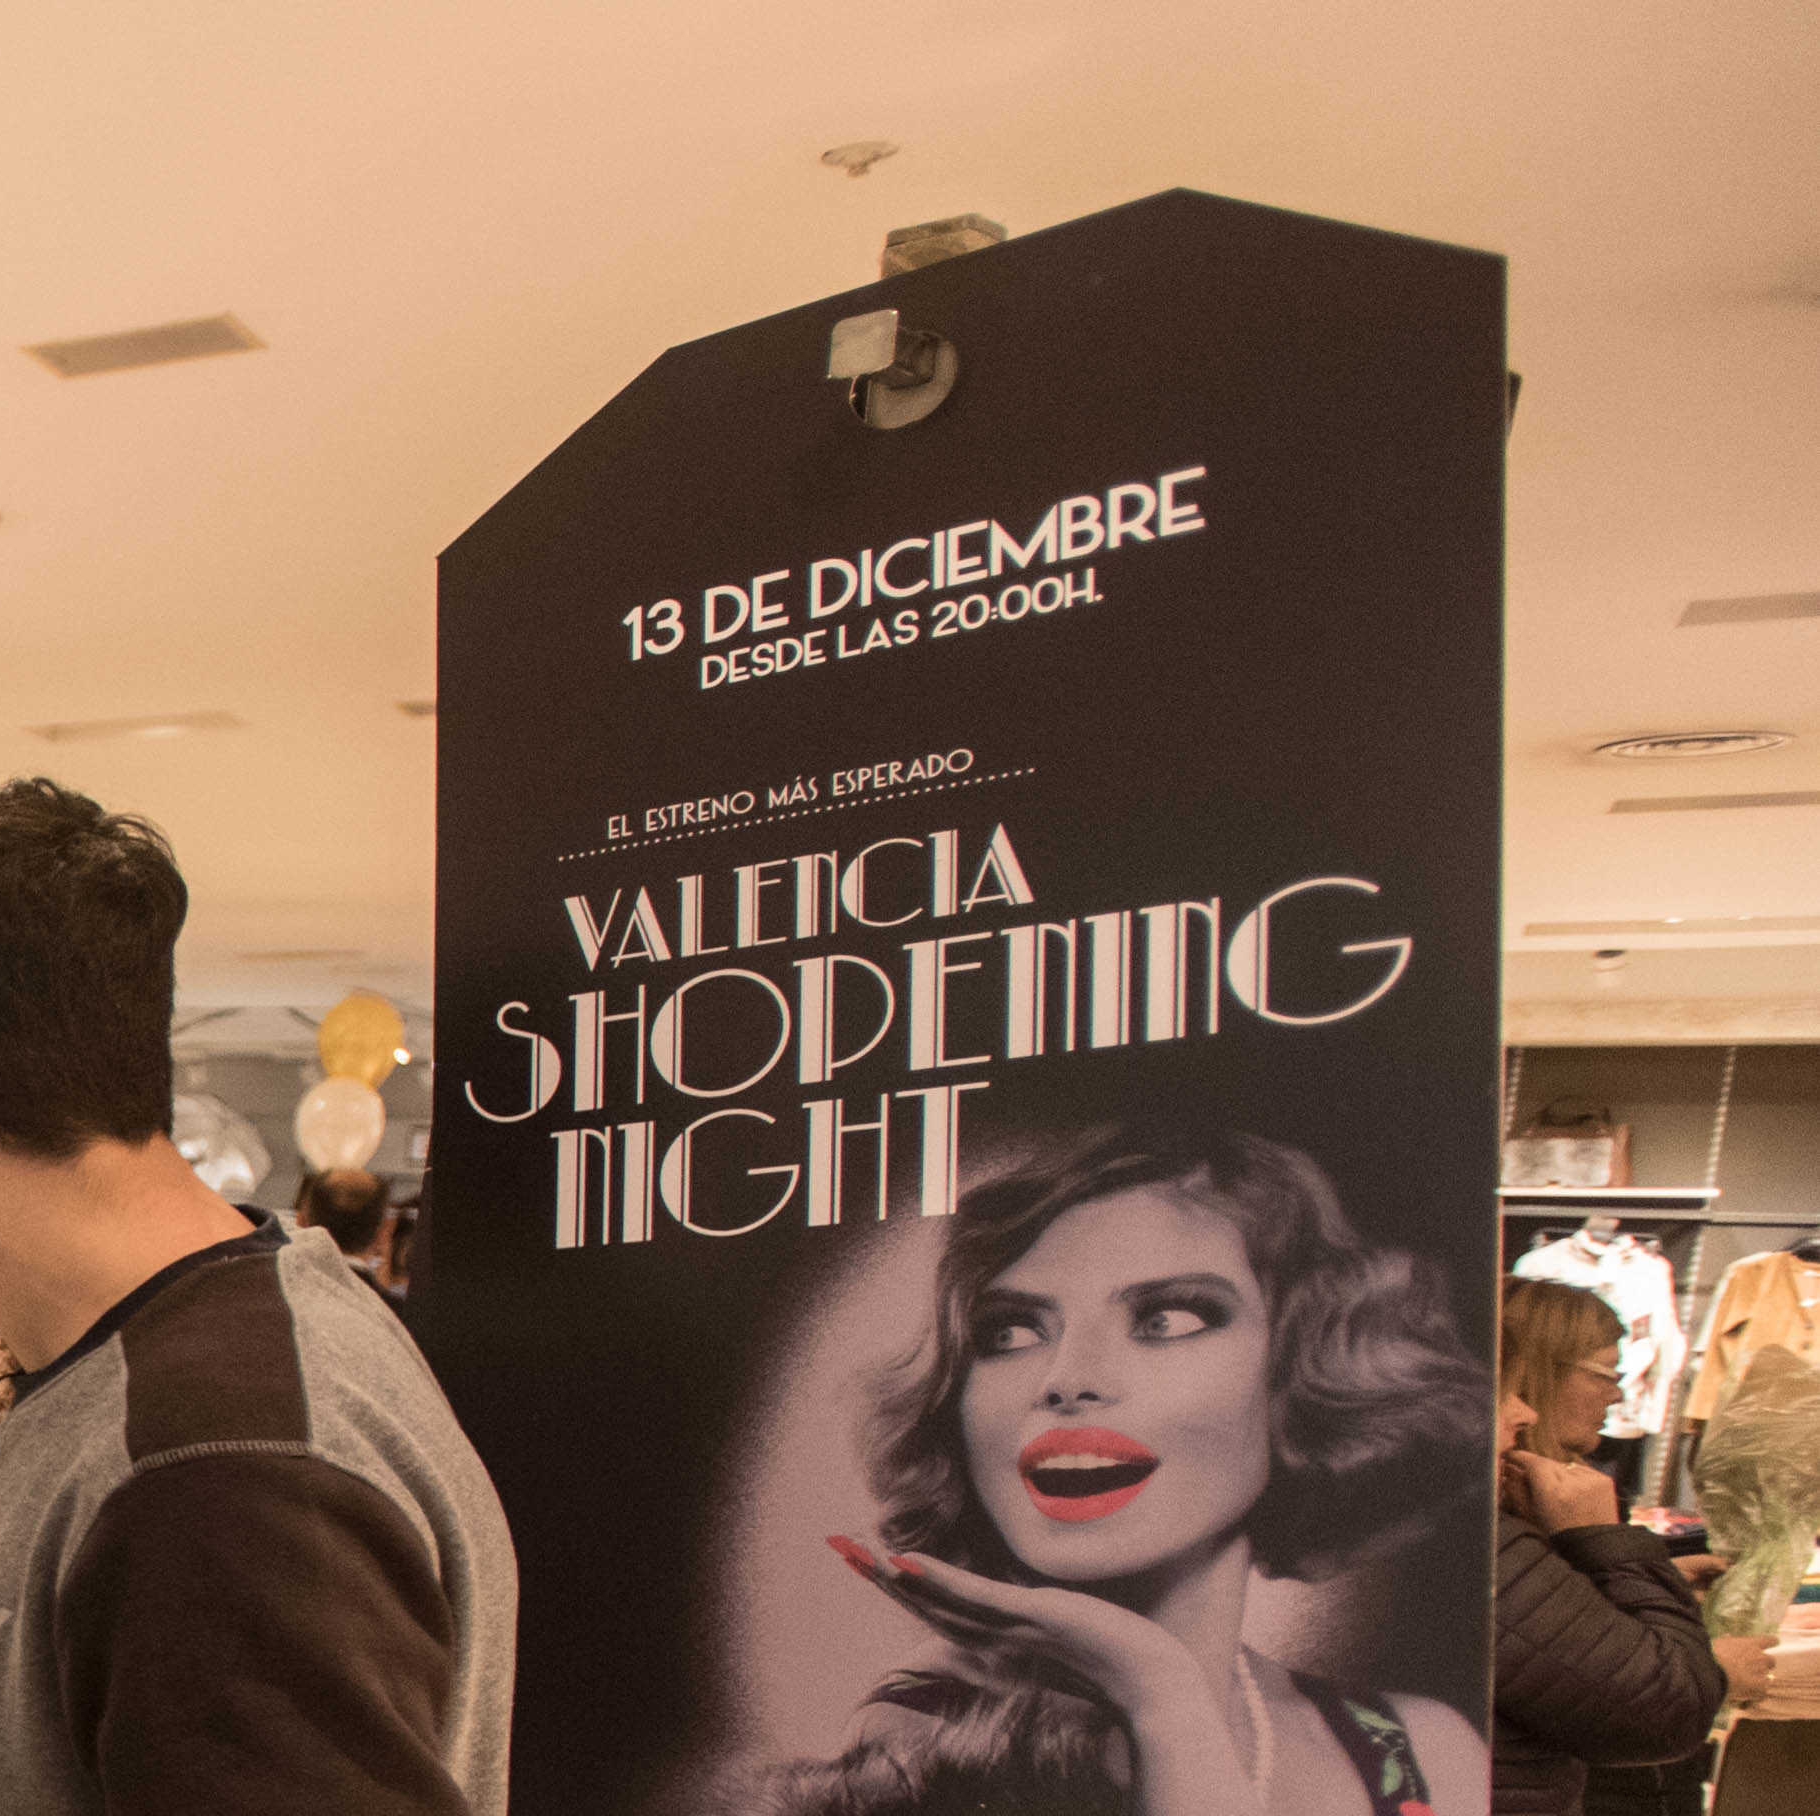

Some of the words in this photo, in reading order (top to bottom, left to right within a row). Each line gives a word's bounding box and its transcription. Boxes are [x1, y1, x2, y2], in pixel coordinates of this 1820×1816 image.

[622, 599, 685, 661] 13
[703, 569, 791, 645] DE
[810, 465, 1207, 619] DICIEMBRE
[700, 629, 828, 690] DESDE
[837, 609, 920, 660] LAS
[607, 814, 633, 840] EL
[645, 786, 756, 833] ESTRENO
[768, 773, 819, 809] MÁS
[832, 748, 974, 797] ESPERADO
[564, 823, 1035, 970] VALENCIA
[464, 876, 1412, 1122] SHOPENING
[551, 1081, 990, 1249] NIGHT
